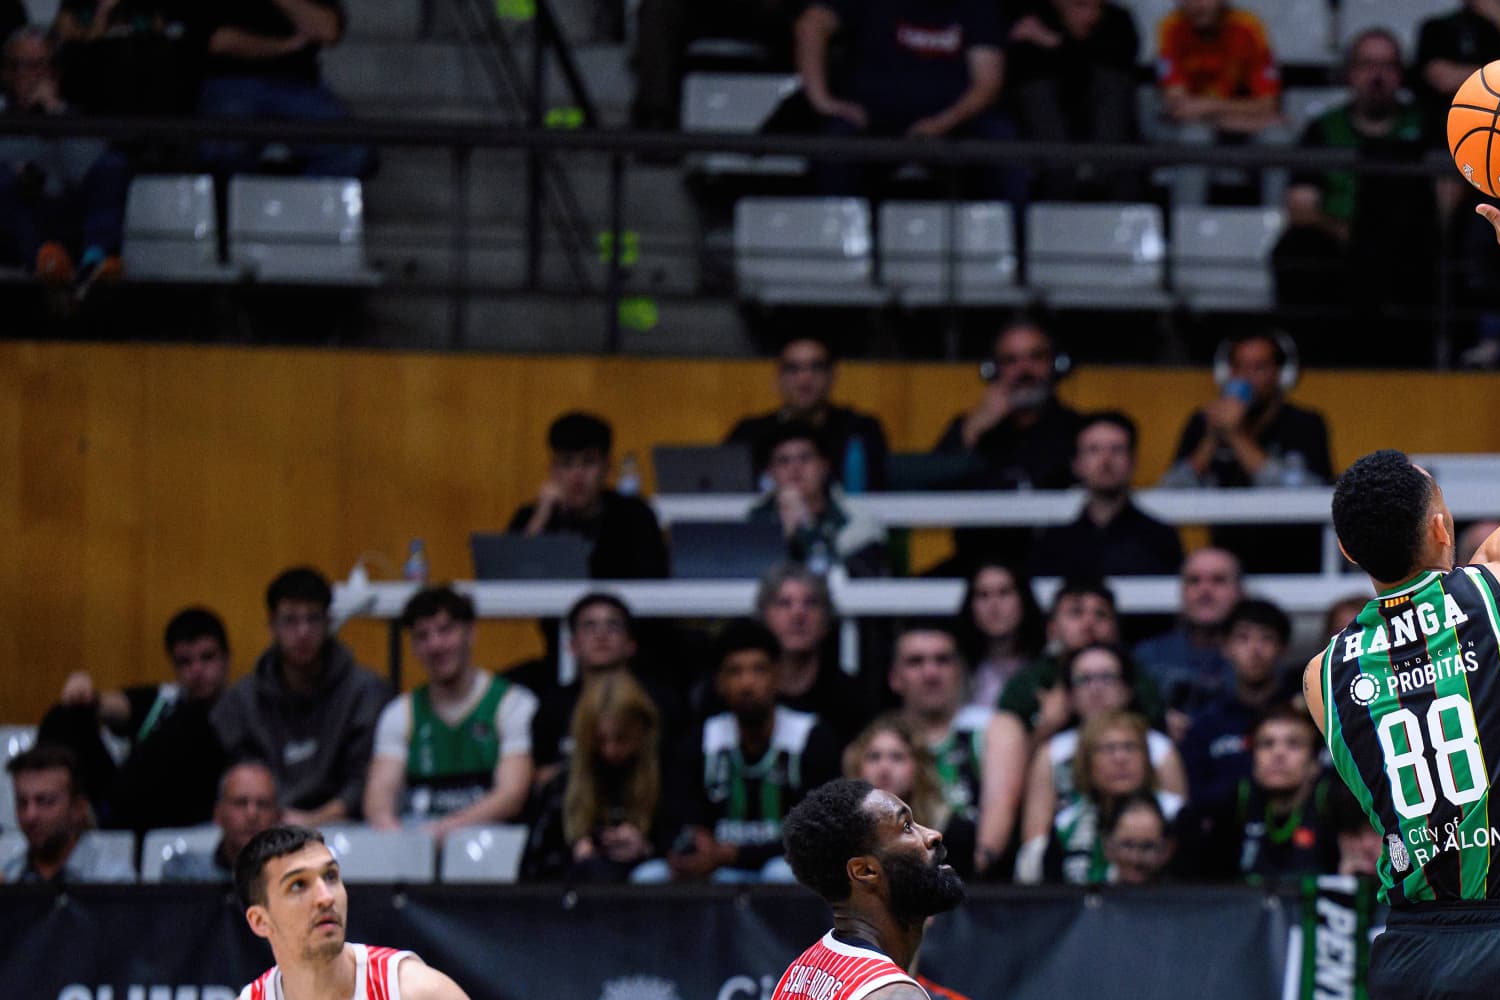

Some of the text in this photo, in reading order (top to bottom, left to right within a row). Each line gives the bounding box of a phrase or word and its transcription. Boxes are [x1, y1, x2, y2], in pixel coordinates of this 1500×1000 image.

[1343, 593, 1470, 663] HANGA
[1386, 650, 1479, 697] PROBITAS
[1377, 693, 1488, 819] 88
[1408, 816, 1461, 846] City of
